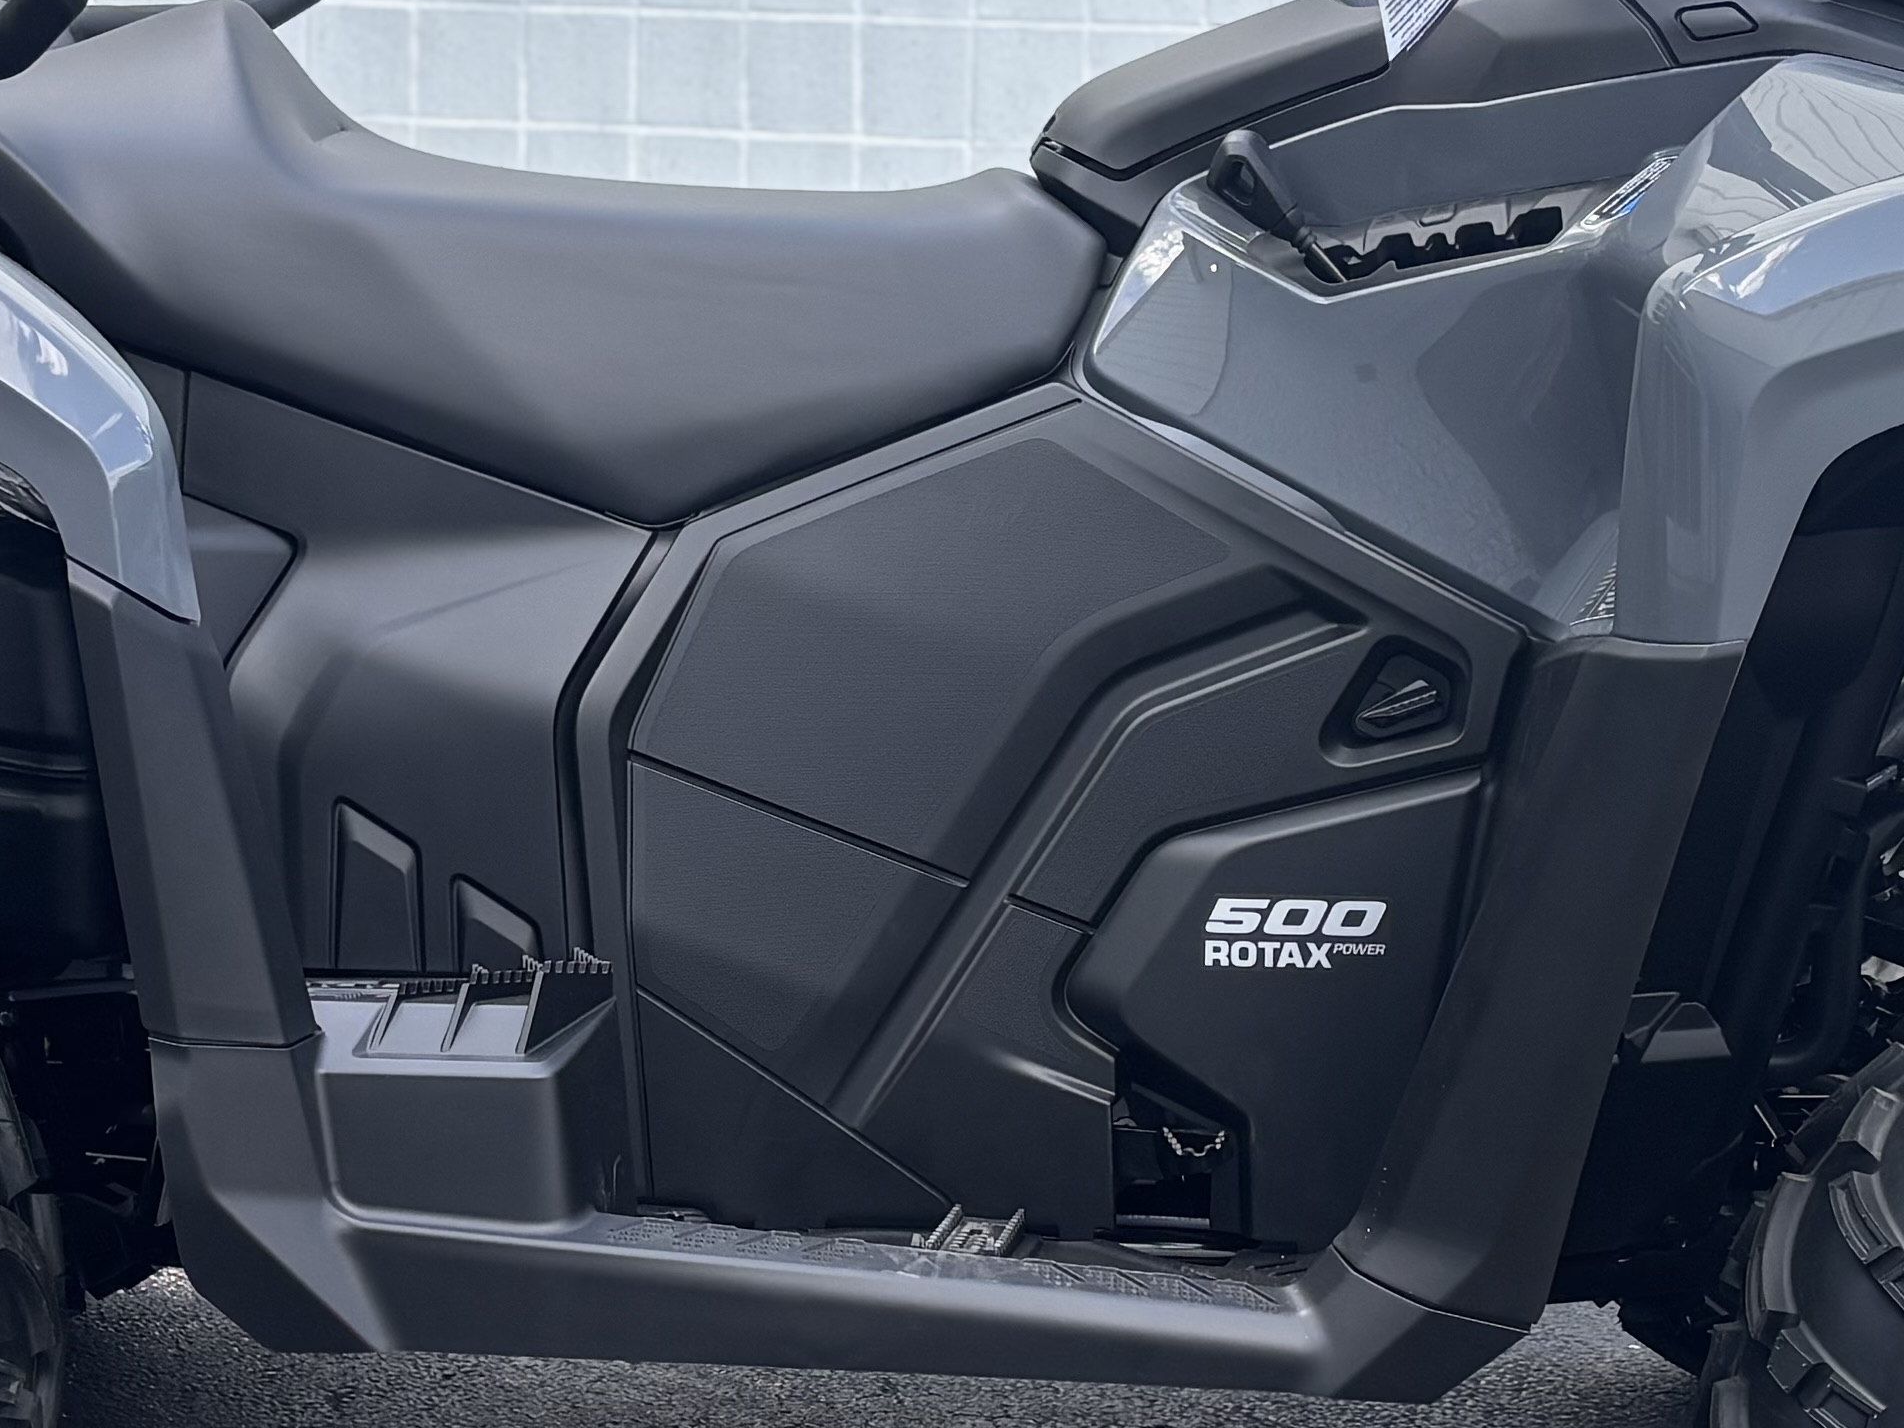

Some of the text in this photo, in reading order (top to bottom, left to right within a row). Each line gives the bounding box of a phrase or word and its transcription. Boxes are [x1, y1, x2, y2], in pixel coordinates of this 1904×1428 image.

[1204, 897, 1388, 937] 500
[1204, 939, 1387, 969] ROTAX POWER
